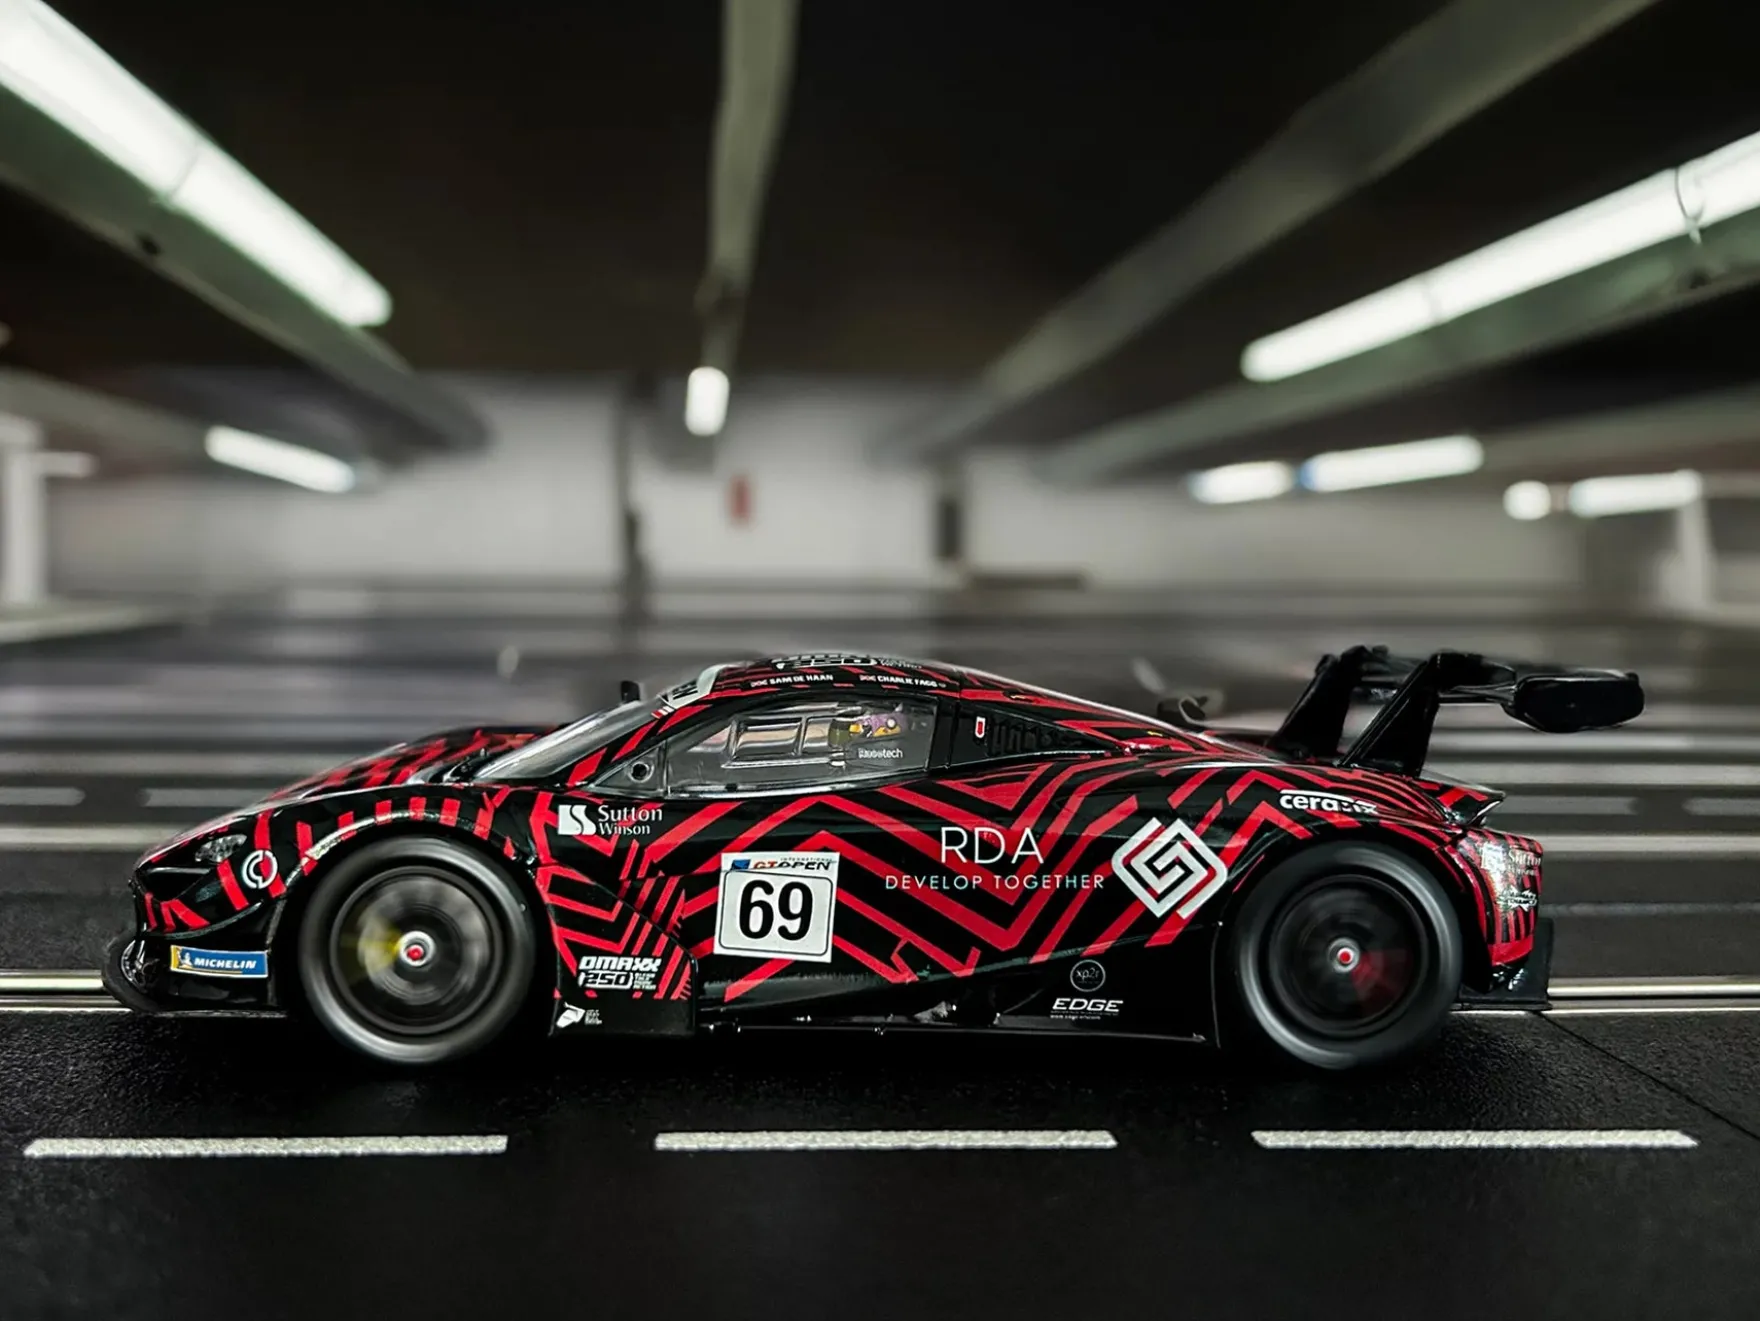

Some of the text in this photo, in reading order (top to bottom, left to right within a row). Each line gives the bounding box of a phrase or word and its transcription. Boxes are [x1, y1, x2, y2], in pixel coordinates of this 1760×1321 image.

[769, 677, 792, 685] SAM
[598, 804, 662, 822] Sutton
[600, 822, 651, 835] Winson
[941, 827, 1044, 864] RDA
[885, 874, 1105, 890] DEVELOP TOGETHER
[739, 879, 814, 941] 69
[194, 957, 257, 969] MICHELIN
[1052, 998, 1124, 1013] EDGE
